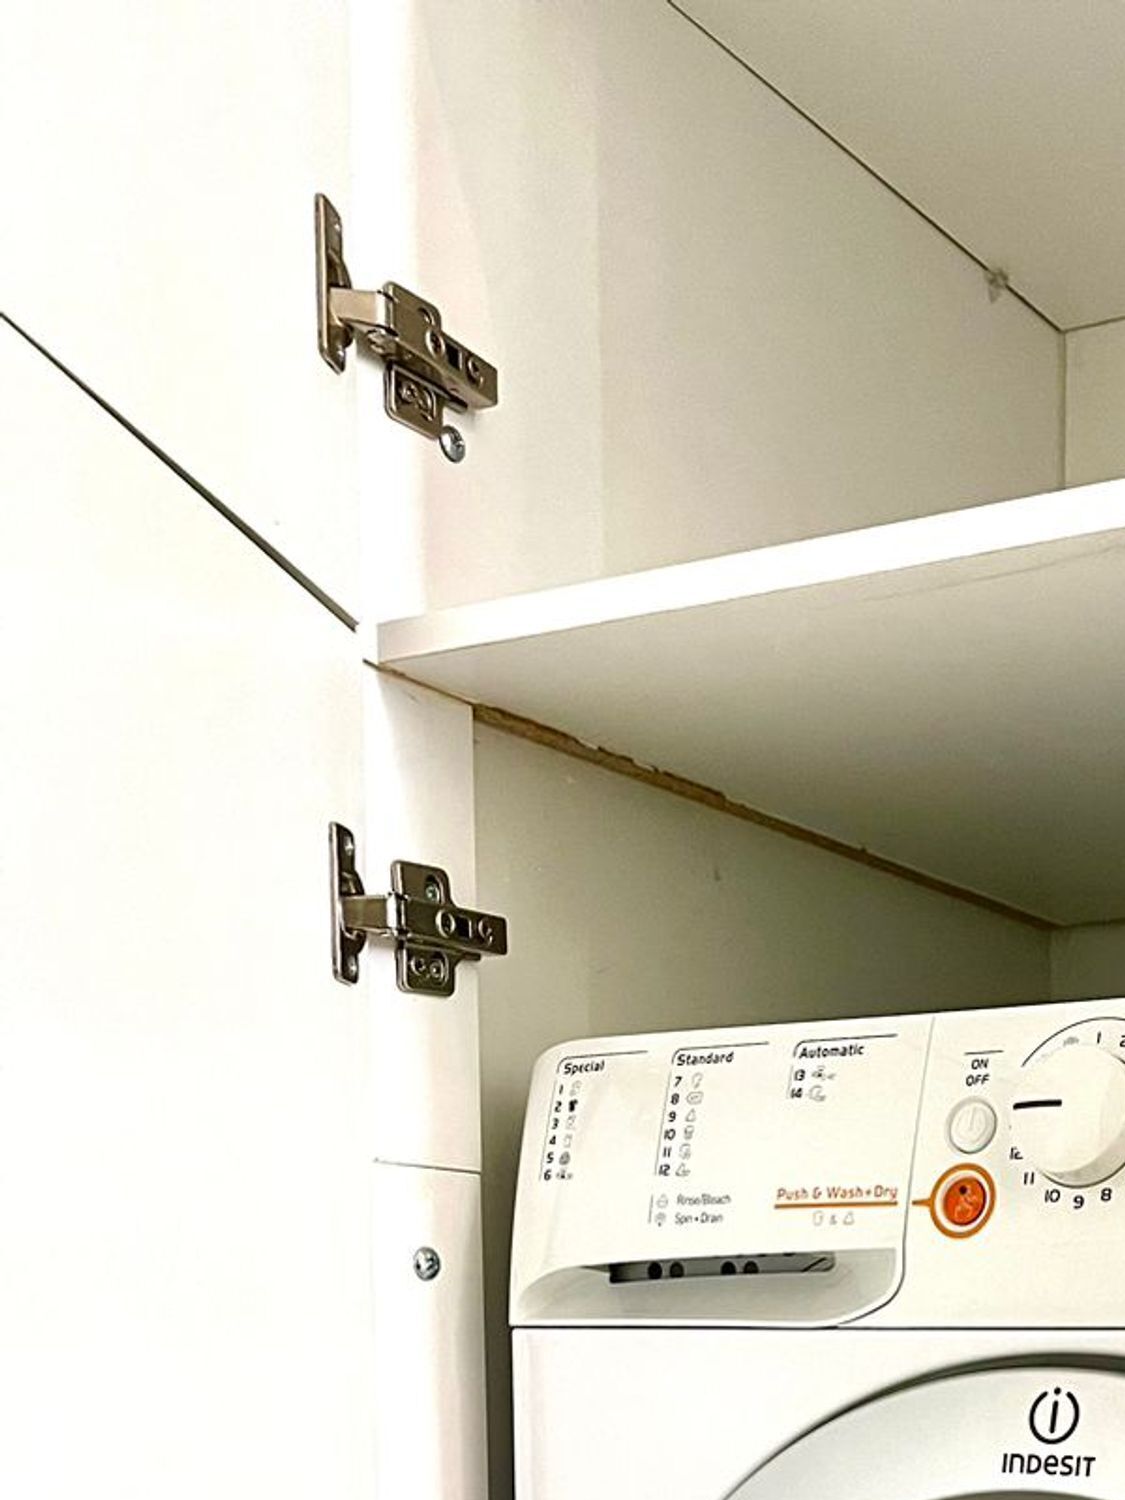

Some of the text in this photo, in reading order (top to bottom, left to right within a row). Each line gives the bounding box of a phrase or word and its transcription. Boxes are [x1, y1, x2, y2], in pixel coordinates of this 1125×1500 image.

[1096, 1032, 1102, 1044] 1
[799, 1044, 865, 1059] Automatic
[676, 1051, 734, 1067] Standard
[971, 1059, 989, 1070] ON
[563, 1060, 605, 1076] Special
[674, 1076, 683, 1087] 7
[965, 1074, 990, 1087] OFF
[670, 1093, 680, 1105] 8
[554, 1101, 562, 1113] 2
[668, 1111, 677, 1123] 9
[552, 1118, 559, 1130] 3
[664, 1128, 676, 1141] 10
[547, 1152, 554, 1164] 5
[663, 1147, 672, 1158] 11
[544, 1169, 552, 1181] 6
[659, 1164, 671, 1177] 12
[1023, 1172, 1035, 1186] 11
[777, 1187, 809, 1201] Push
[1044, 1189, 1061, 1204] 10
[1100, 1188, 1112, 1201] 8
[1073, 1195, 1085, 1209] 9
